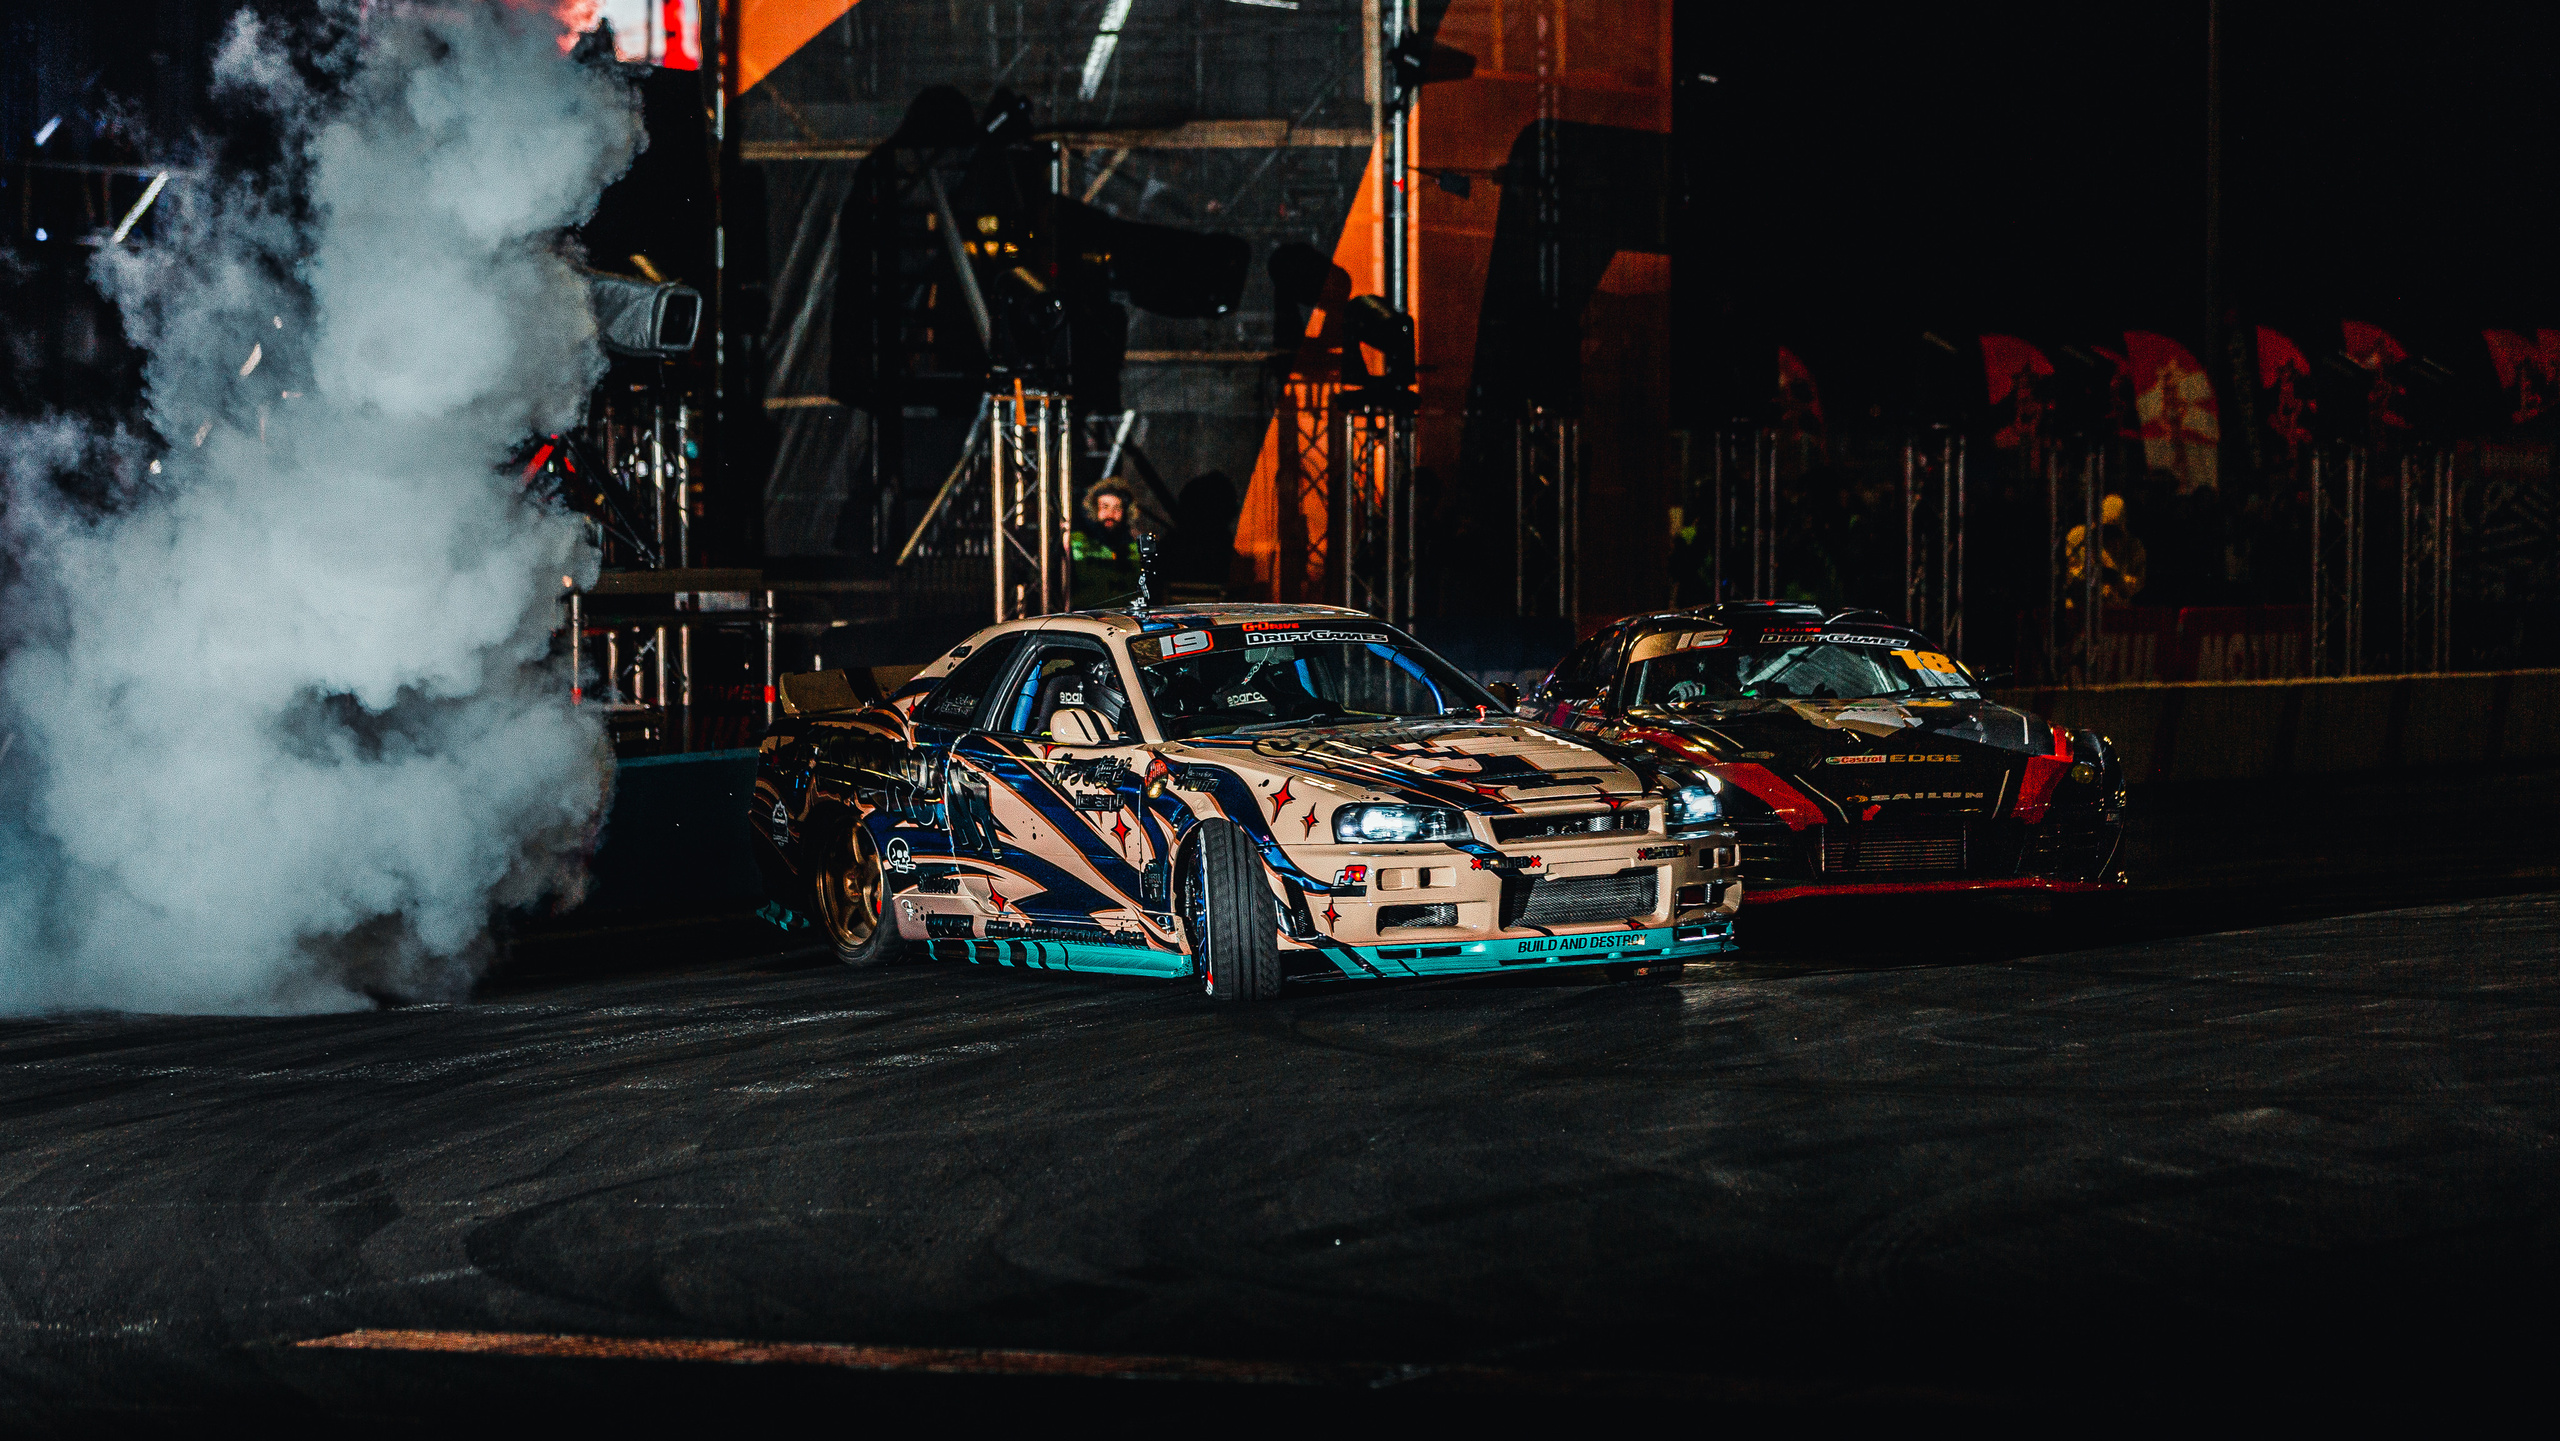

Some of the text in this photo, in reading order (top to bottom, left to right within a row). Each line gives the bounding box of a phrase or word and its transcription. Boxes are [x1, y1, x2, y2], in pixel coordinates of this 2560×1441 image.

[1159, 630, 1213, 659] 19
[1246, 630, 1389, 645] DRIFT GAMES
[1889, 649, 1957, 674] 18
[1841, 754, 1962, 764] Castrol EDGE
[1870, 792, 1984, 801] SAILUN
[1518, 933, 1648, 953] BUILD AND DESTROY
